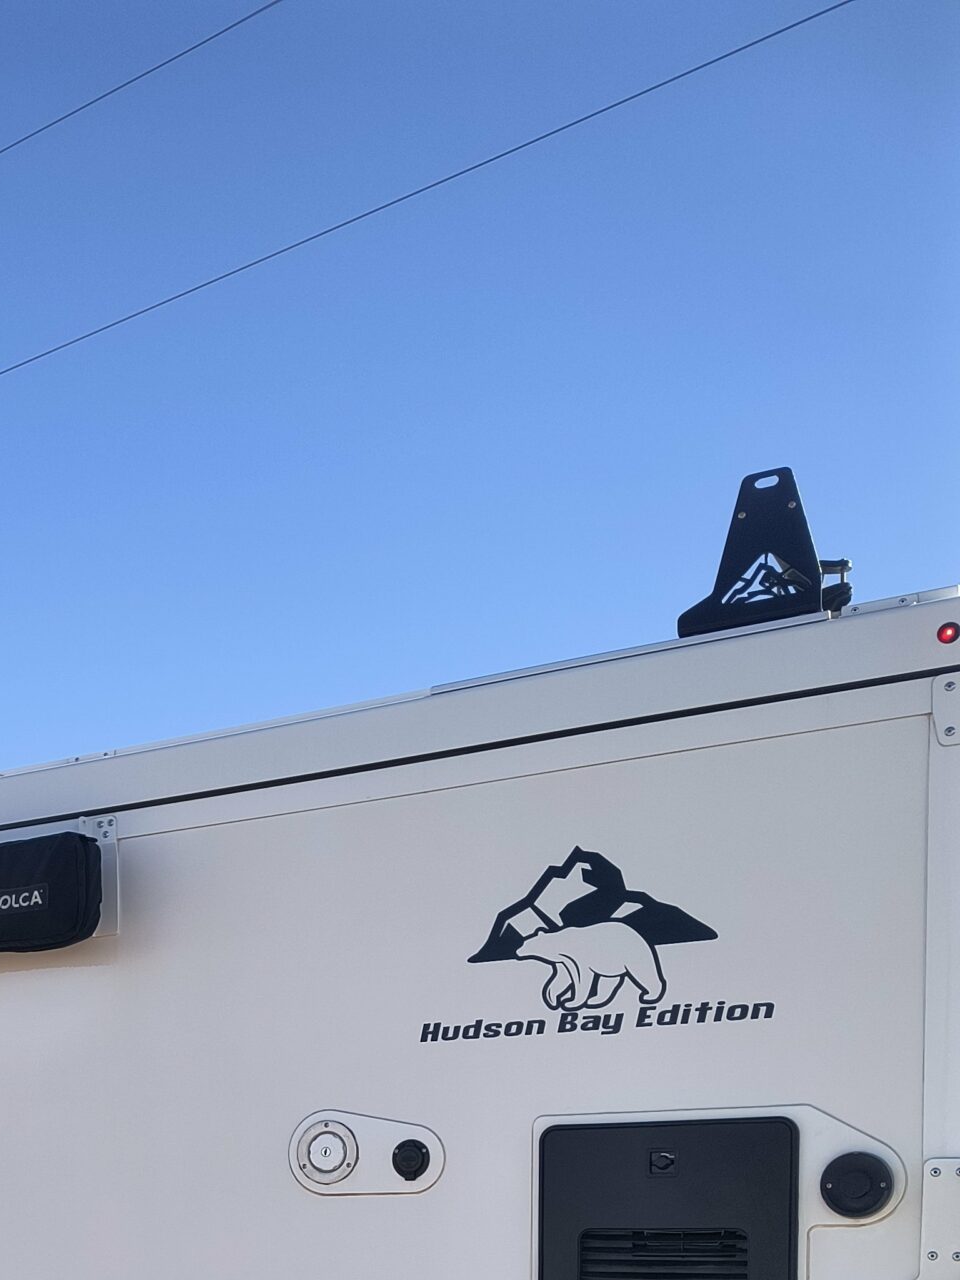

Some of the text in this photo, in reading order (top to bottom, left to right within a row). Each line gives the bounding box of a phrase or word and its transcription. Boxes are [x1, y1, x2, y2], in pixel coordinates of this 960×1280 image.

[420, 1002, 775, 1042] Hudson Bay Edition
